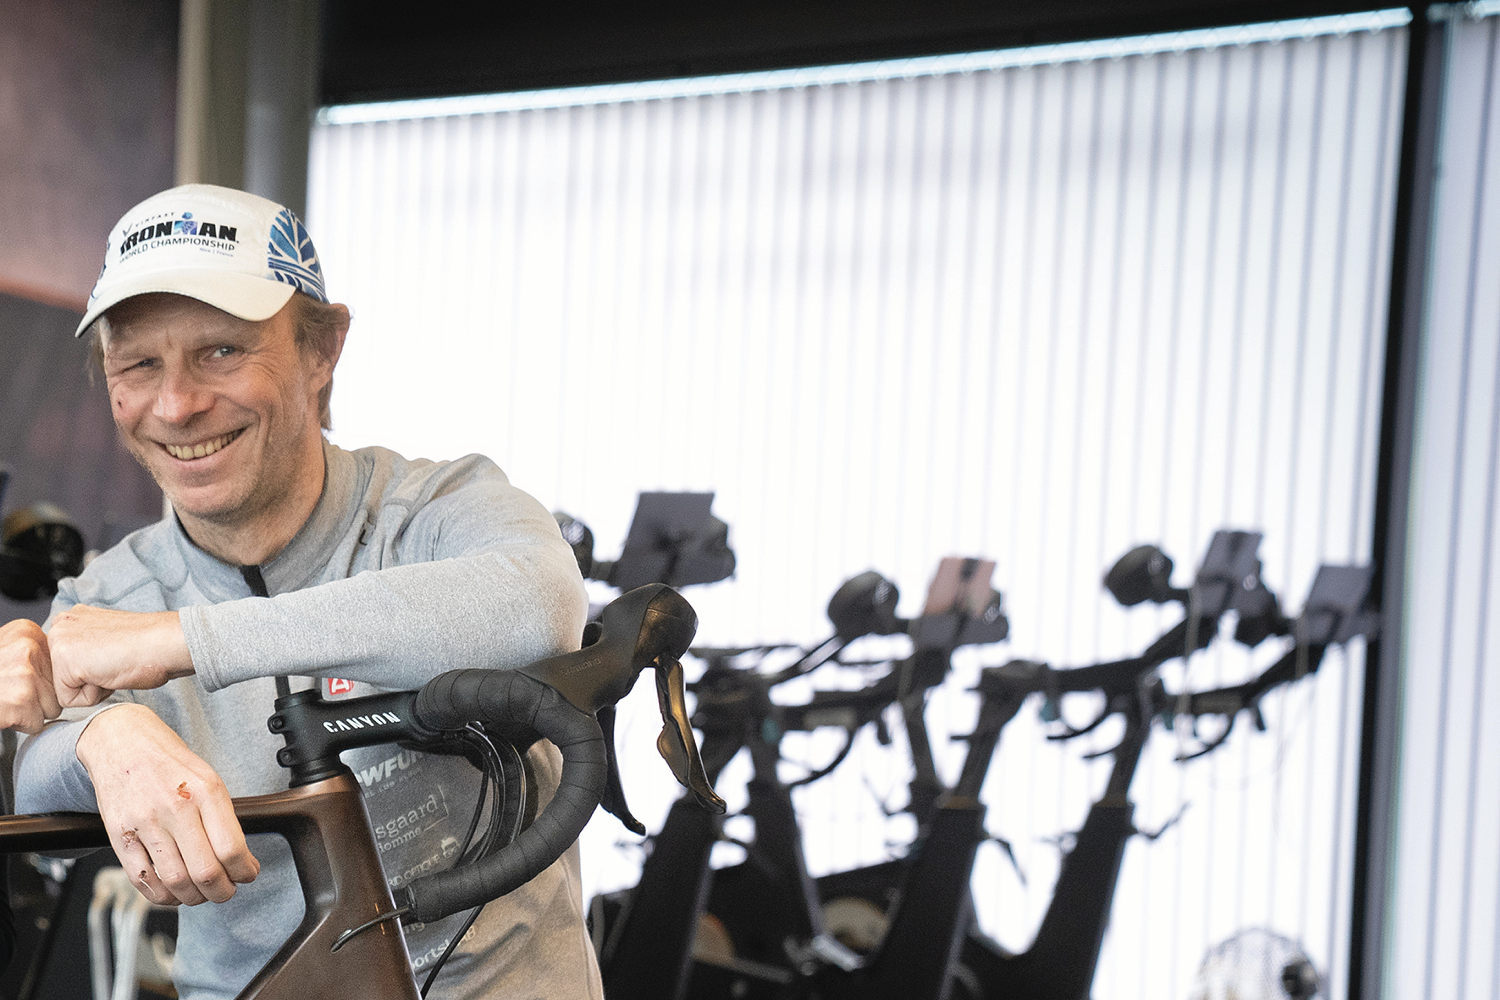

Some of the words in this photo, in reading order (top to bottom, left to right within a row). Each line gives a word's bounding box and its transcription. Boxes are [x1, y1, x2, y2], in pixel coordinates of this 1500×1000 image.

[120, 212, 238, 257] IRONMAN
[151, 237, 235, 251] CHAMPIONSHIP
[323, 711, 401, 733] CANYON
[375, 794, 438, 839] sgaard
